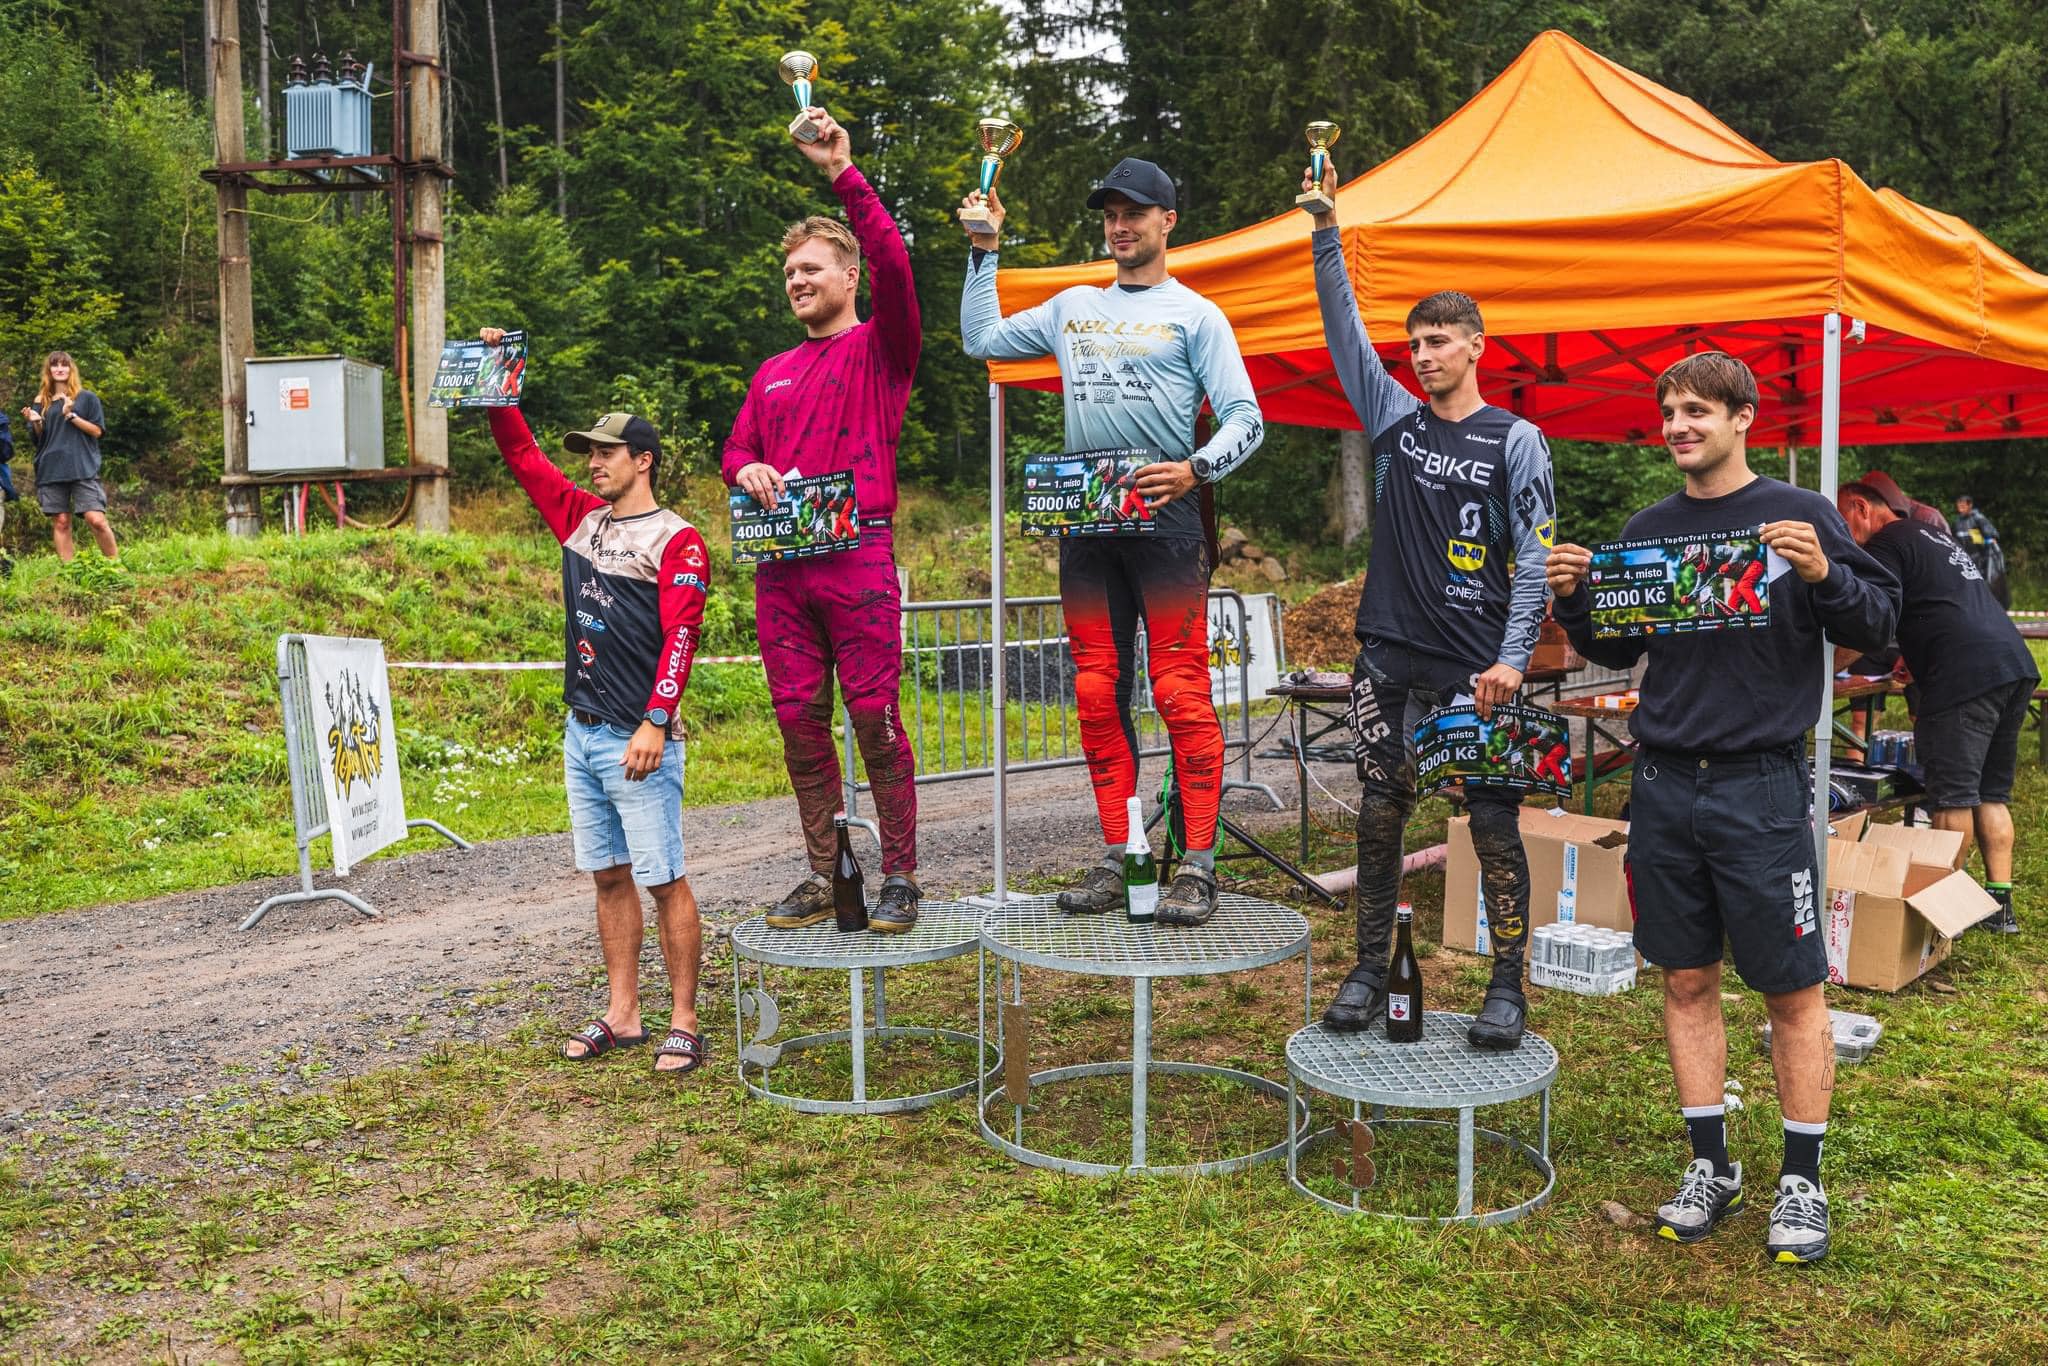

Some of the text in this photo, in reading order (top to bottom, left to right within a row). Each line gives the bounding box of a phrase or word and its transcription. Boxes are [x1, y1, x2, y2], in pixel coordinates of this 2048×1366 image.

[438, 372, 475, 387] 1000 Kč
[1060, 452, 1084, 461] Downhill
[821, 475, 833, 483] Cup
[834, 472, 846, 480] 2024
[1054, 478, 1081, 489] 1. místo
[1027, 493, 1081, 511] 5000 Kč
[760, 509, 768, 517] 2.
[736, 520, 793, 539] 4000 Kč
[1600, 528, 1750, 551] Czech Downhill TopOnTrail Cup 2024
[1623, 567, 1663, 581] 4. místo
[1595, 585, 1667, 609] 2000 Kč
[1440, 705, 1475, 715] Downhill
[1492, 705, 1520, 714] OnTrail
[1522, 709, 1536, 718] Cup
[1539, 713, 1557, 722] 2024
[1437, 729, 1475, 743] 3. místo
[1419, 745, 1478, 776] 3000 Kč
[1547, 968, 1592, 985] MONSTER
